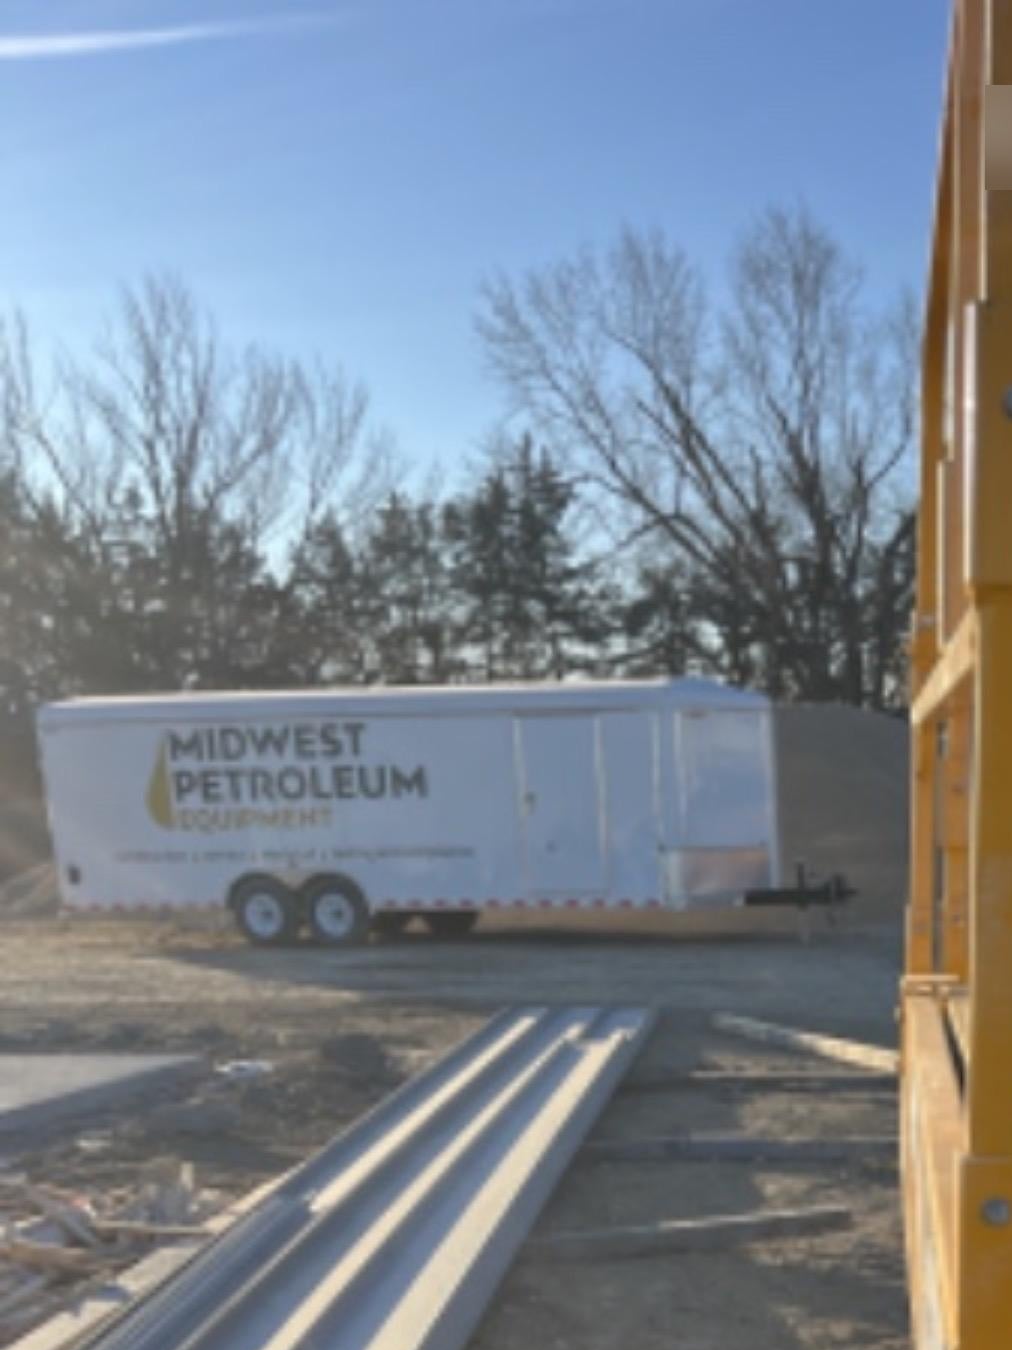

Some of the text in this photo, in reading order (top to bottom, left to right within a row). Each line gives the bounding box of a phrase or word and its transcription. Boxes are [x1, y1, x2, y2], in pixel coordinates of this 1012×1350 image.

[169, 722, 366, 762] MIDWEST
[175, 765, 428, 803] PETROLEUM
[180, 807, 333, 833] EQUIPMENT
